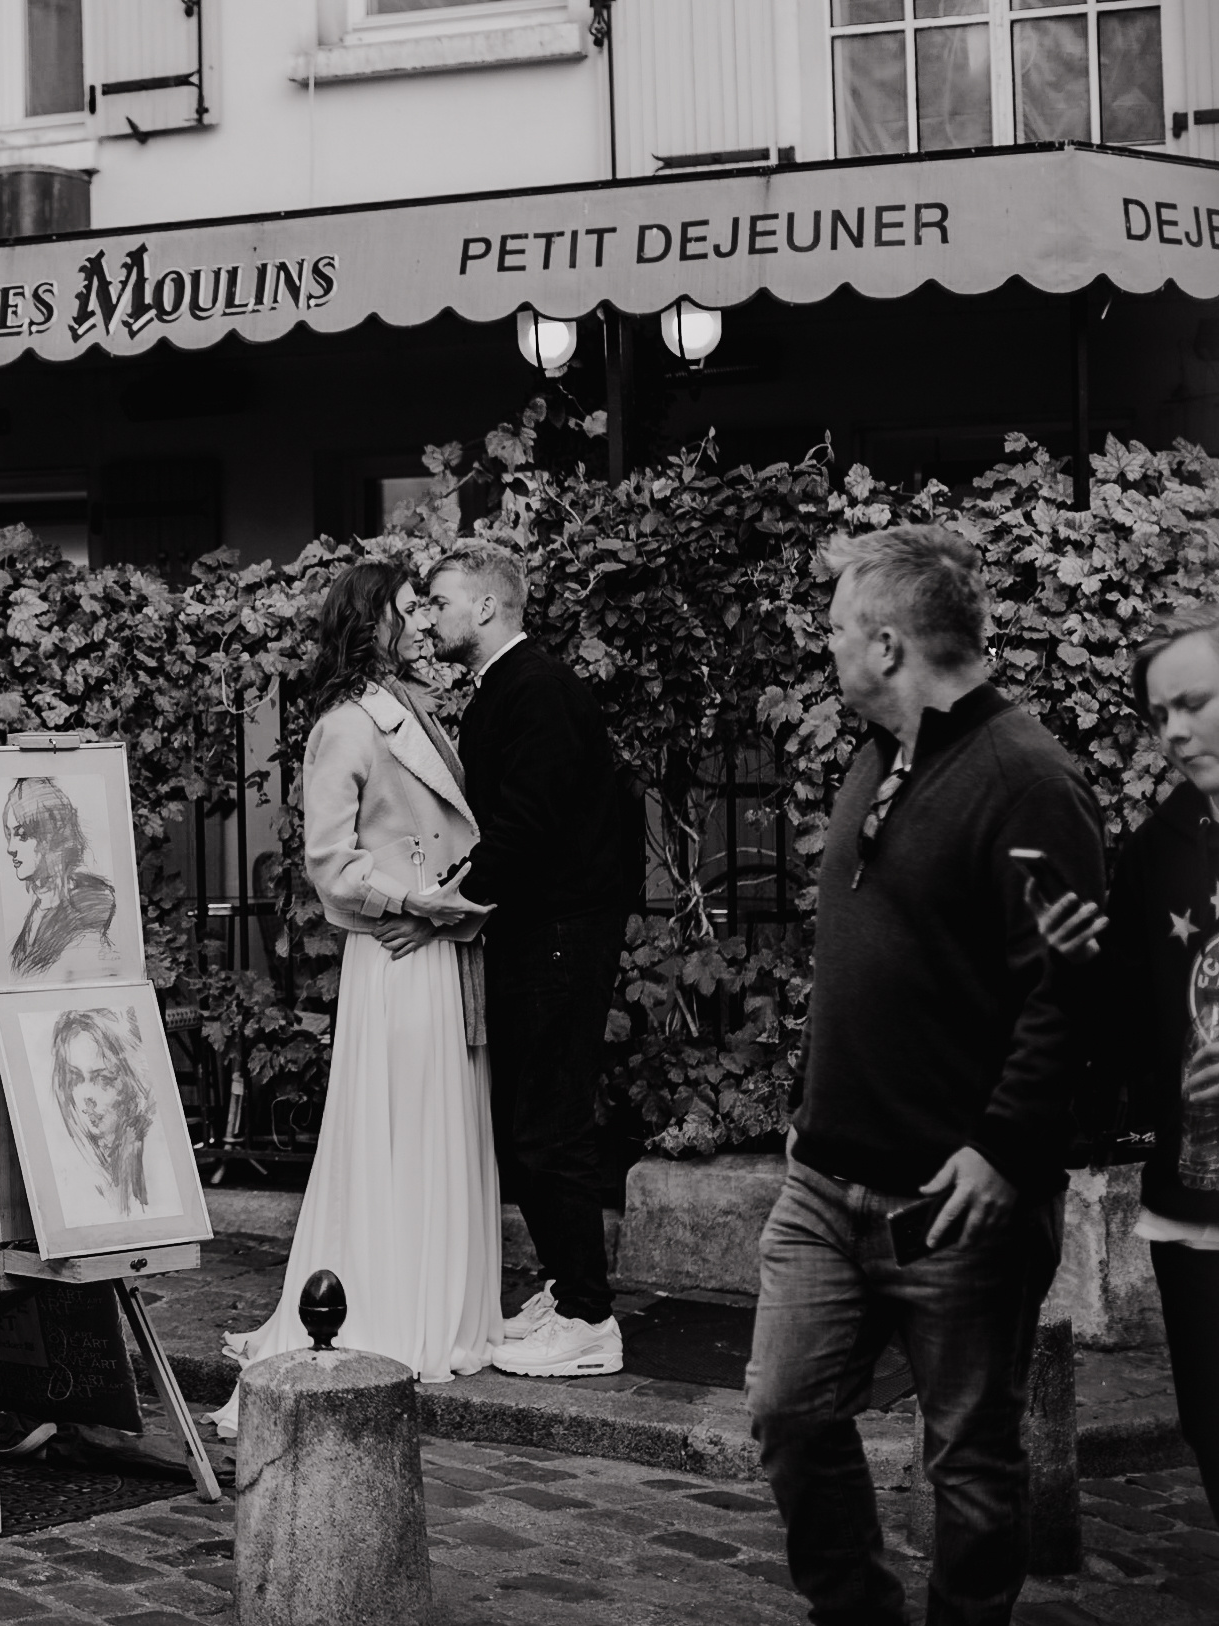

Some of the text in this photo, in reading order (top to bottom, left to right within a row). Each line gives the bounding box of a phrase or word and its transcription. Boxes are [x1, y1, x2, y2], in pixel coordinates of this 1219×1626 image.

[459, 201, 952, 276] PETIT DEJEUNER
[68, 242, 339, 342] MOULINS
[82, 1337, 109, 1350] ART
[91, 1358, 118, 1370] ART
